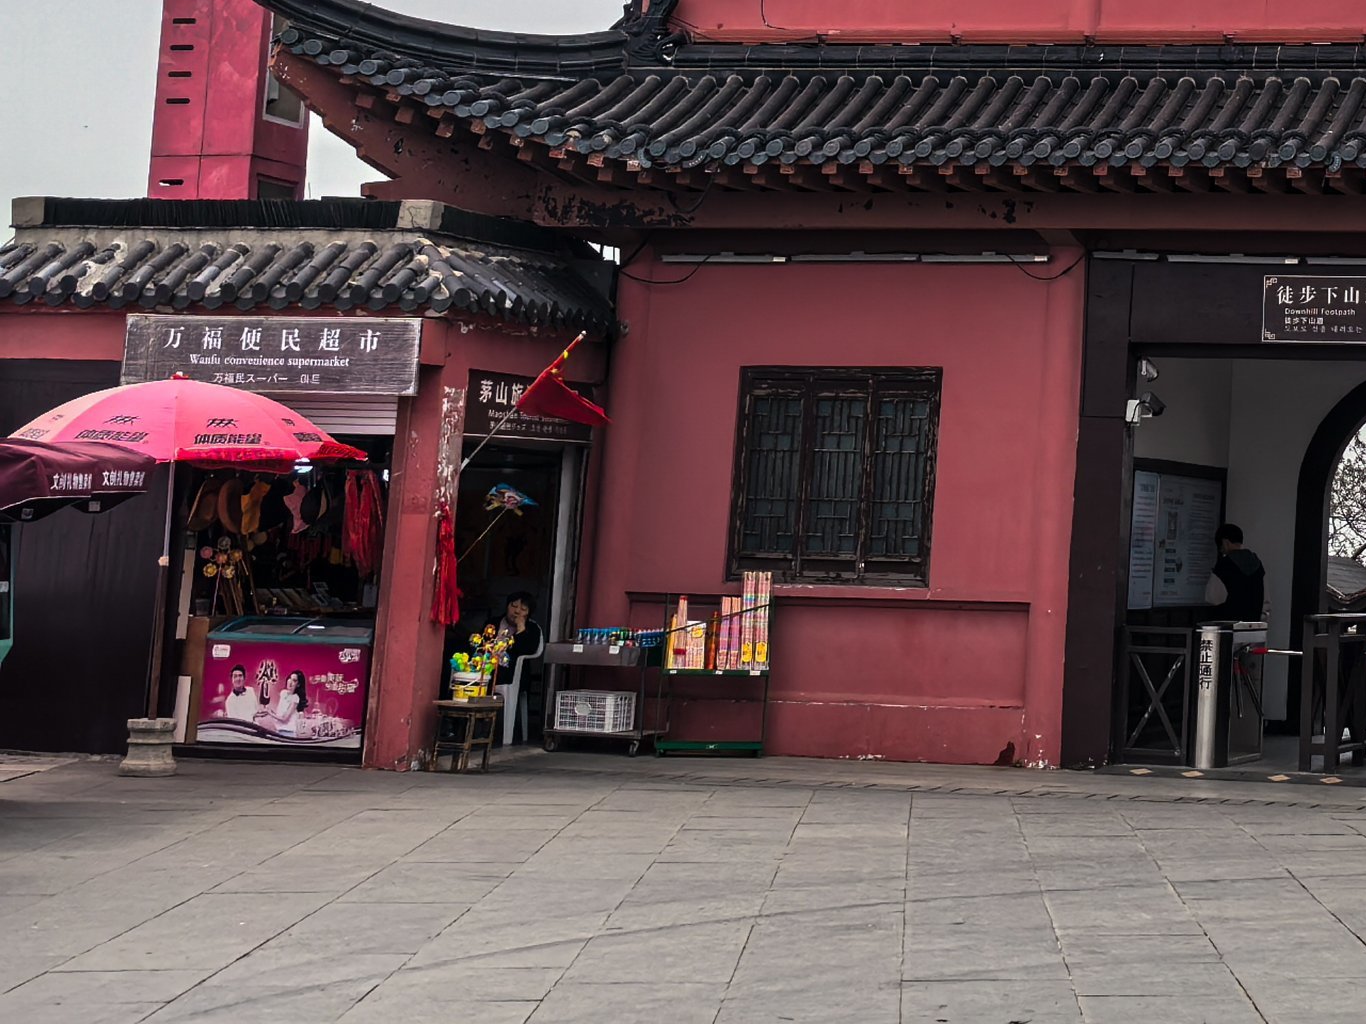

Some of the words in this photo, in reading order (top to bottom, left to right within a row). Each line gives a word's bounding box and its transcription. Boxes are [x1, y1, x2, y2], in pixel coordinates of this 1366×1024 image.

[1284, 307, 1318, 315] Downhill
[163, 326, 382, 354] 万福便民超市
[189, 354, 221, 365] Wanfu
[224, 355, 285, 366] convenience
[287, 356, 350, 368] supermarket
[1199, 639, 1214, 690] 禁止通行
